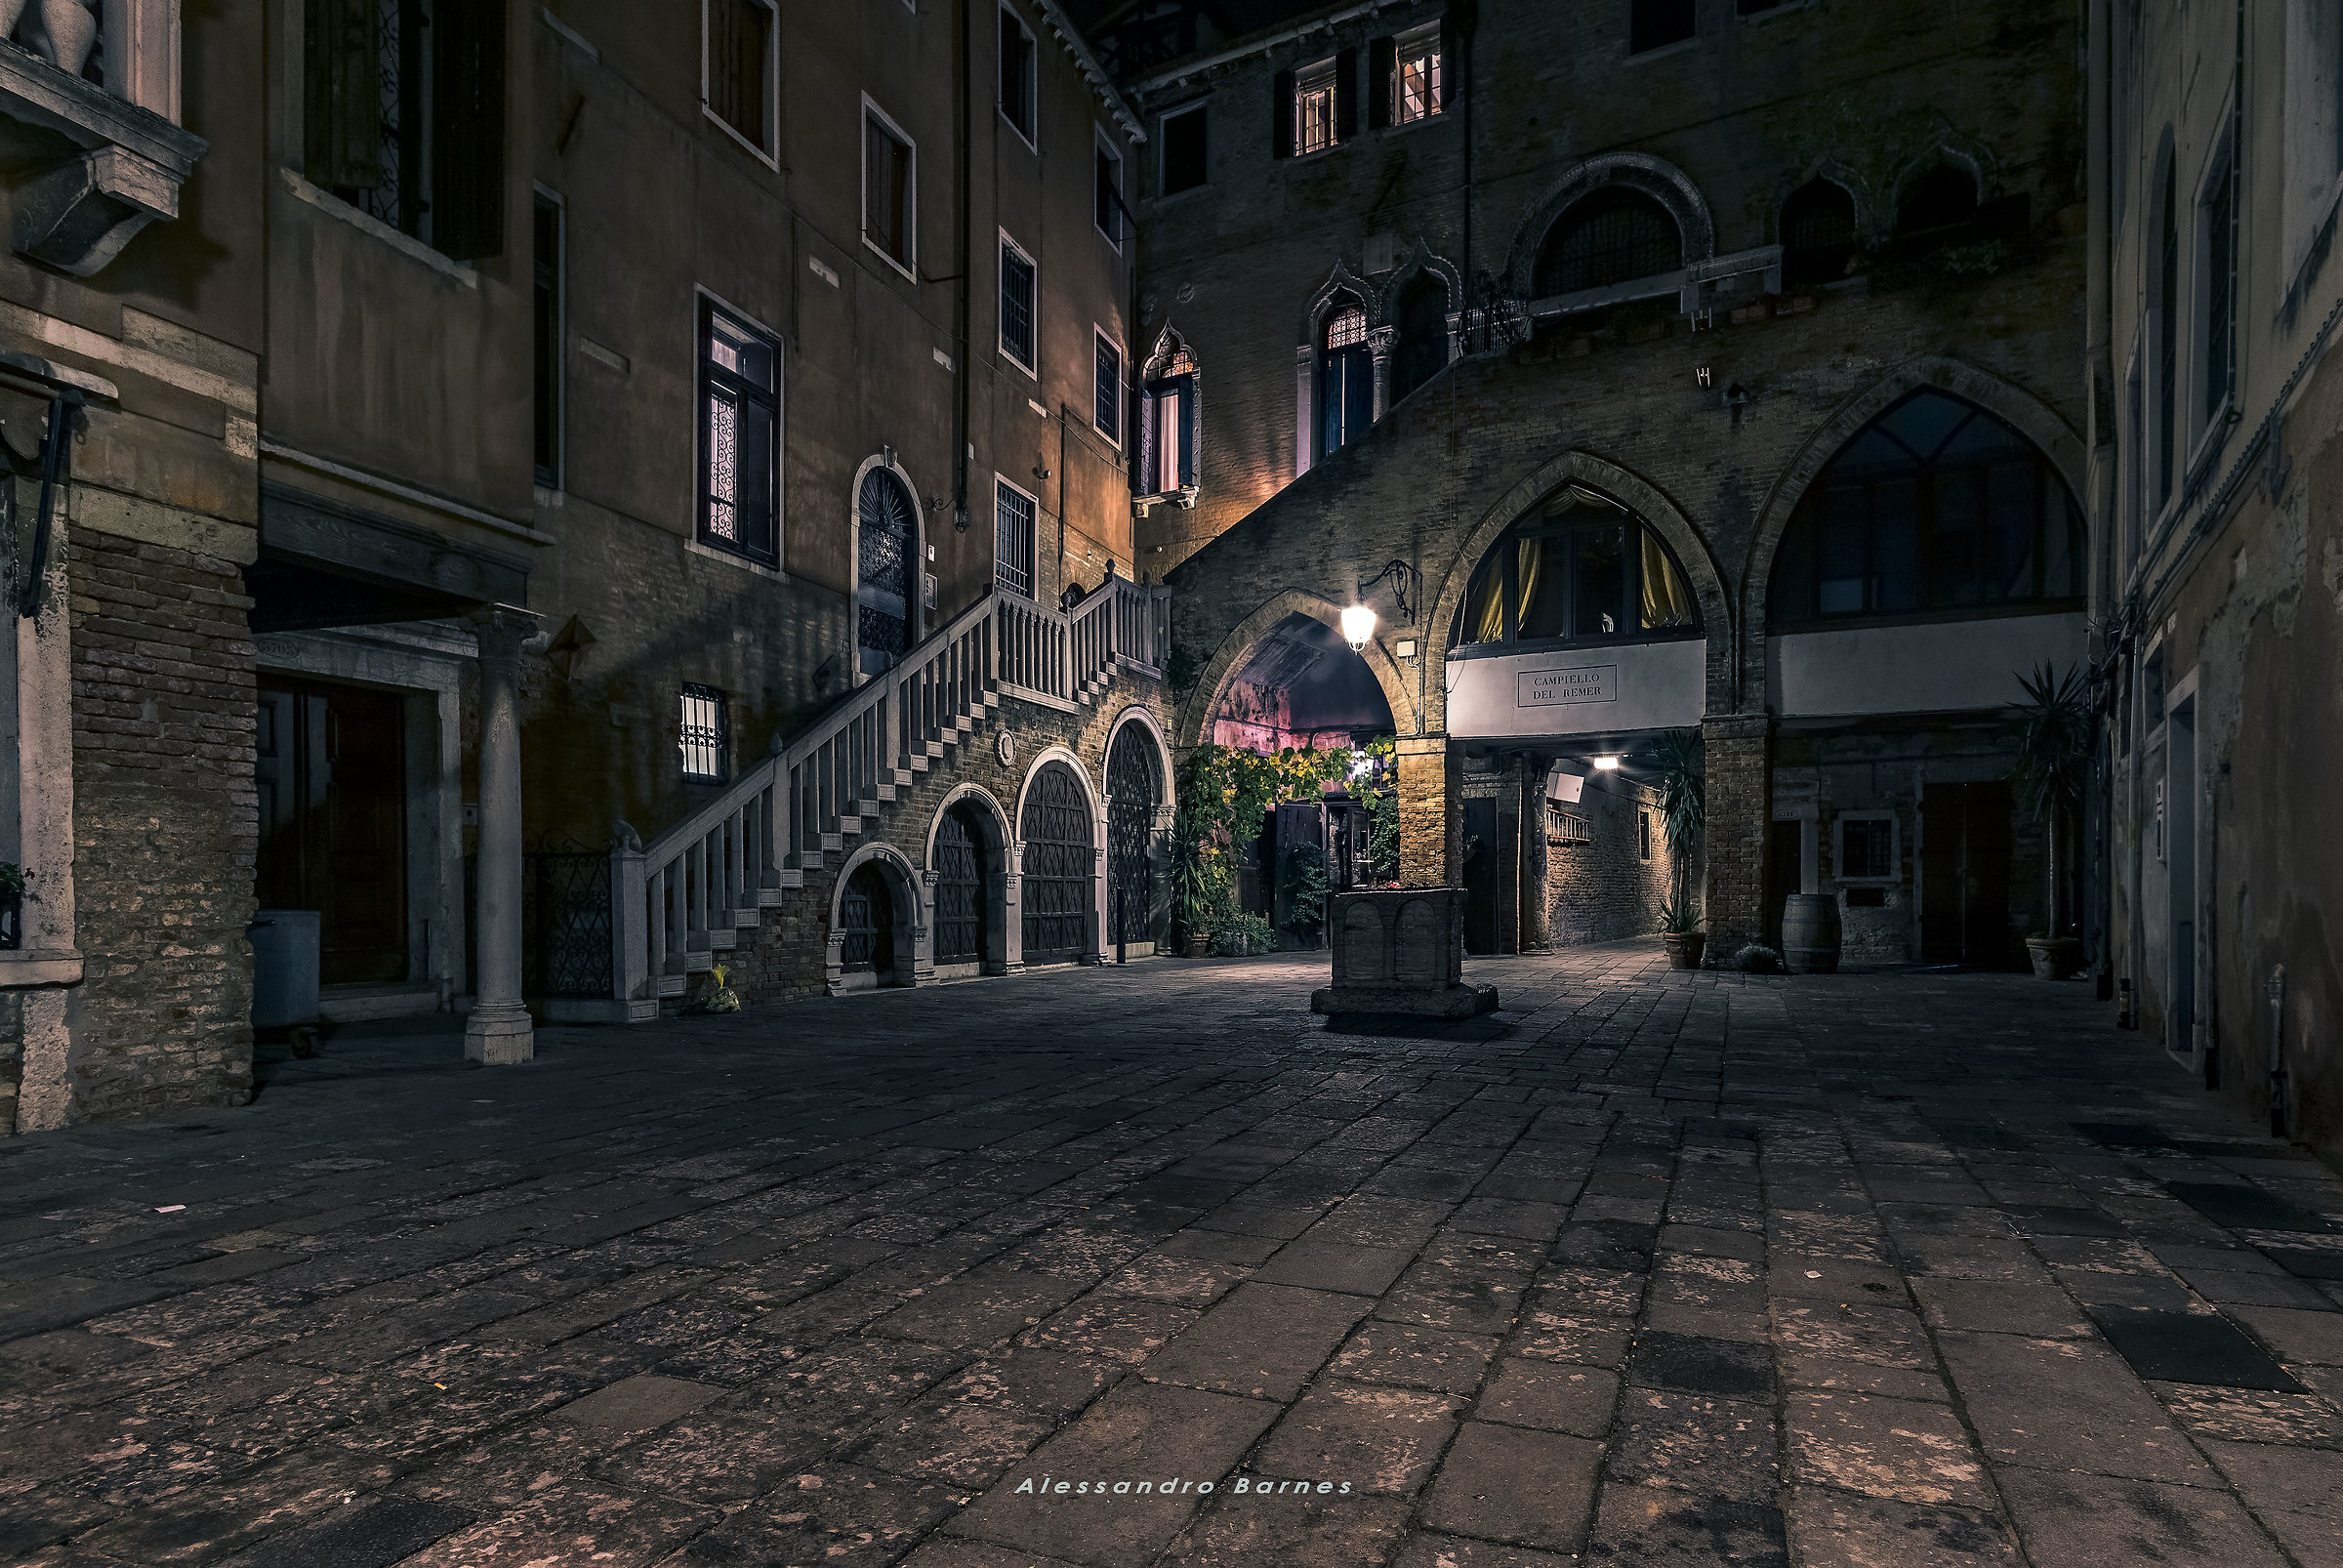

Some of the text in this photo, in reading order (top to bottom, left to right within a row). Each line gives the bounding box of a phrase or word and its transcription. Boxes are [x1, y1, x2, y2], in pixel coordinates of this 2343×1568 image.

[1534, 674, 1600, 686] CAMPIELLO
[1533, 686, 1601, 700] DEL REMER
